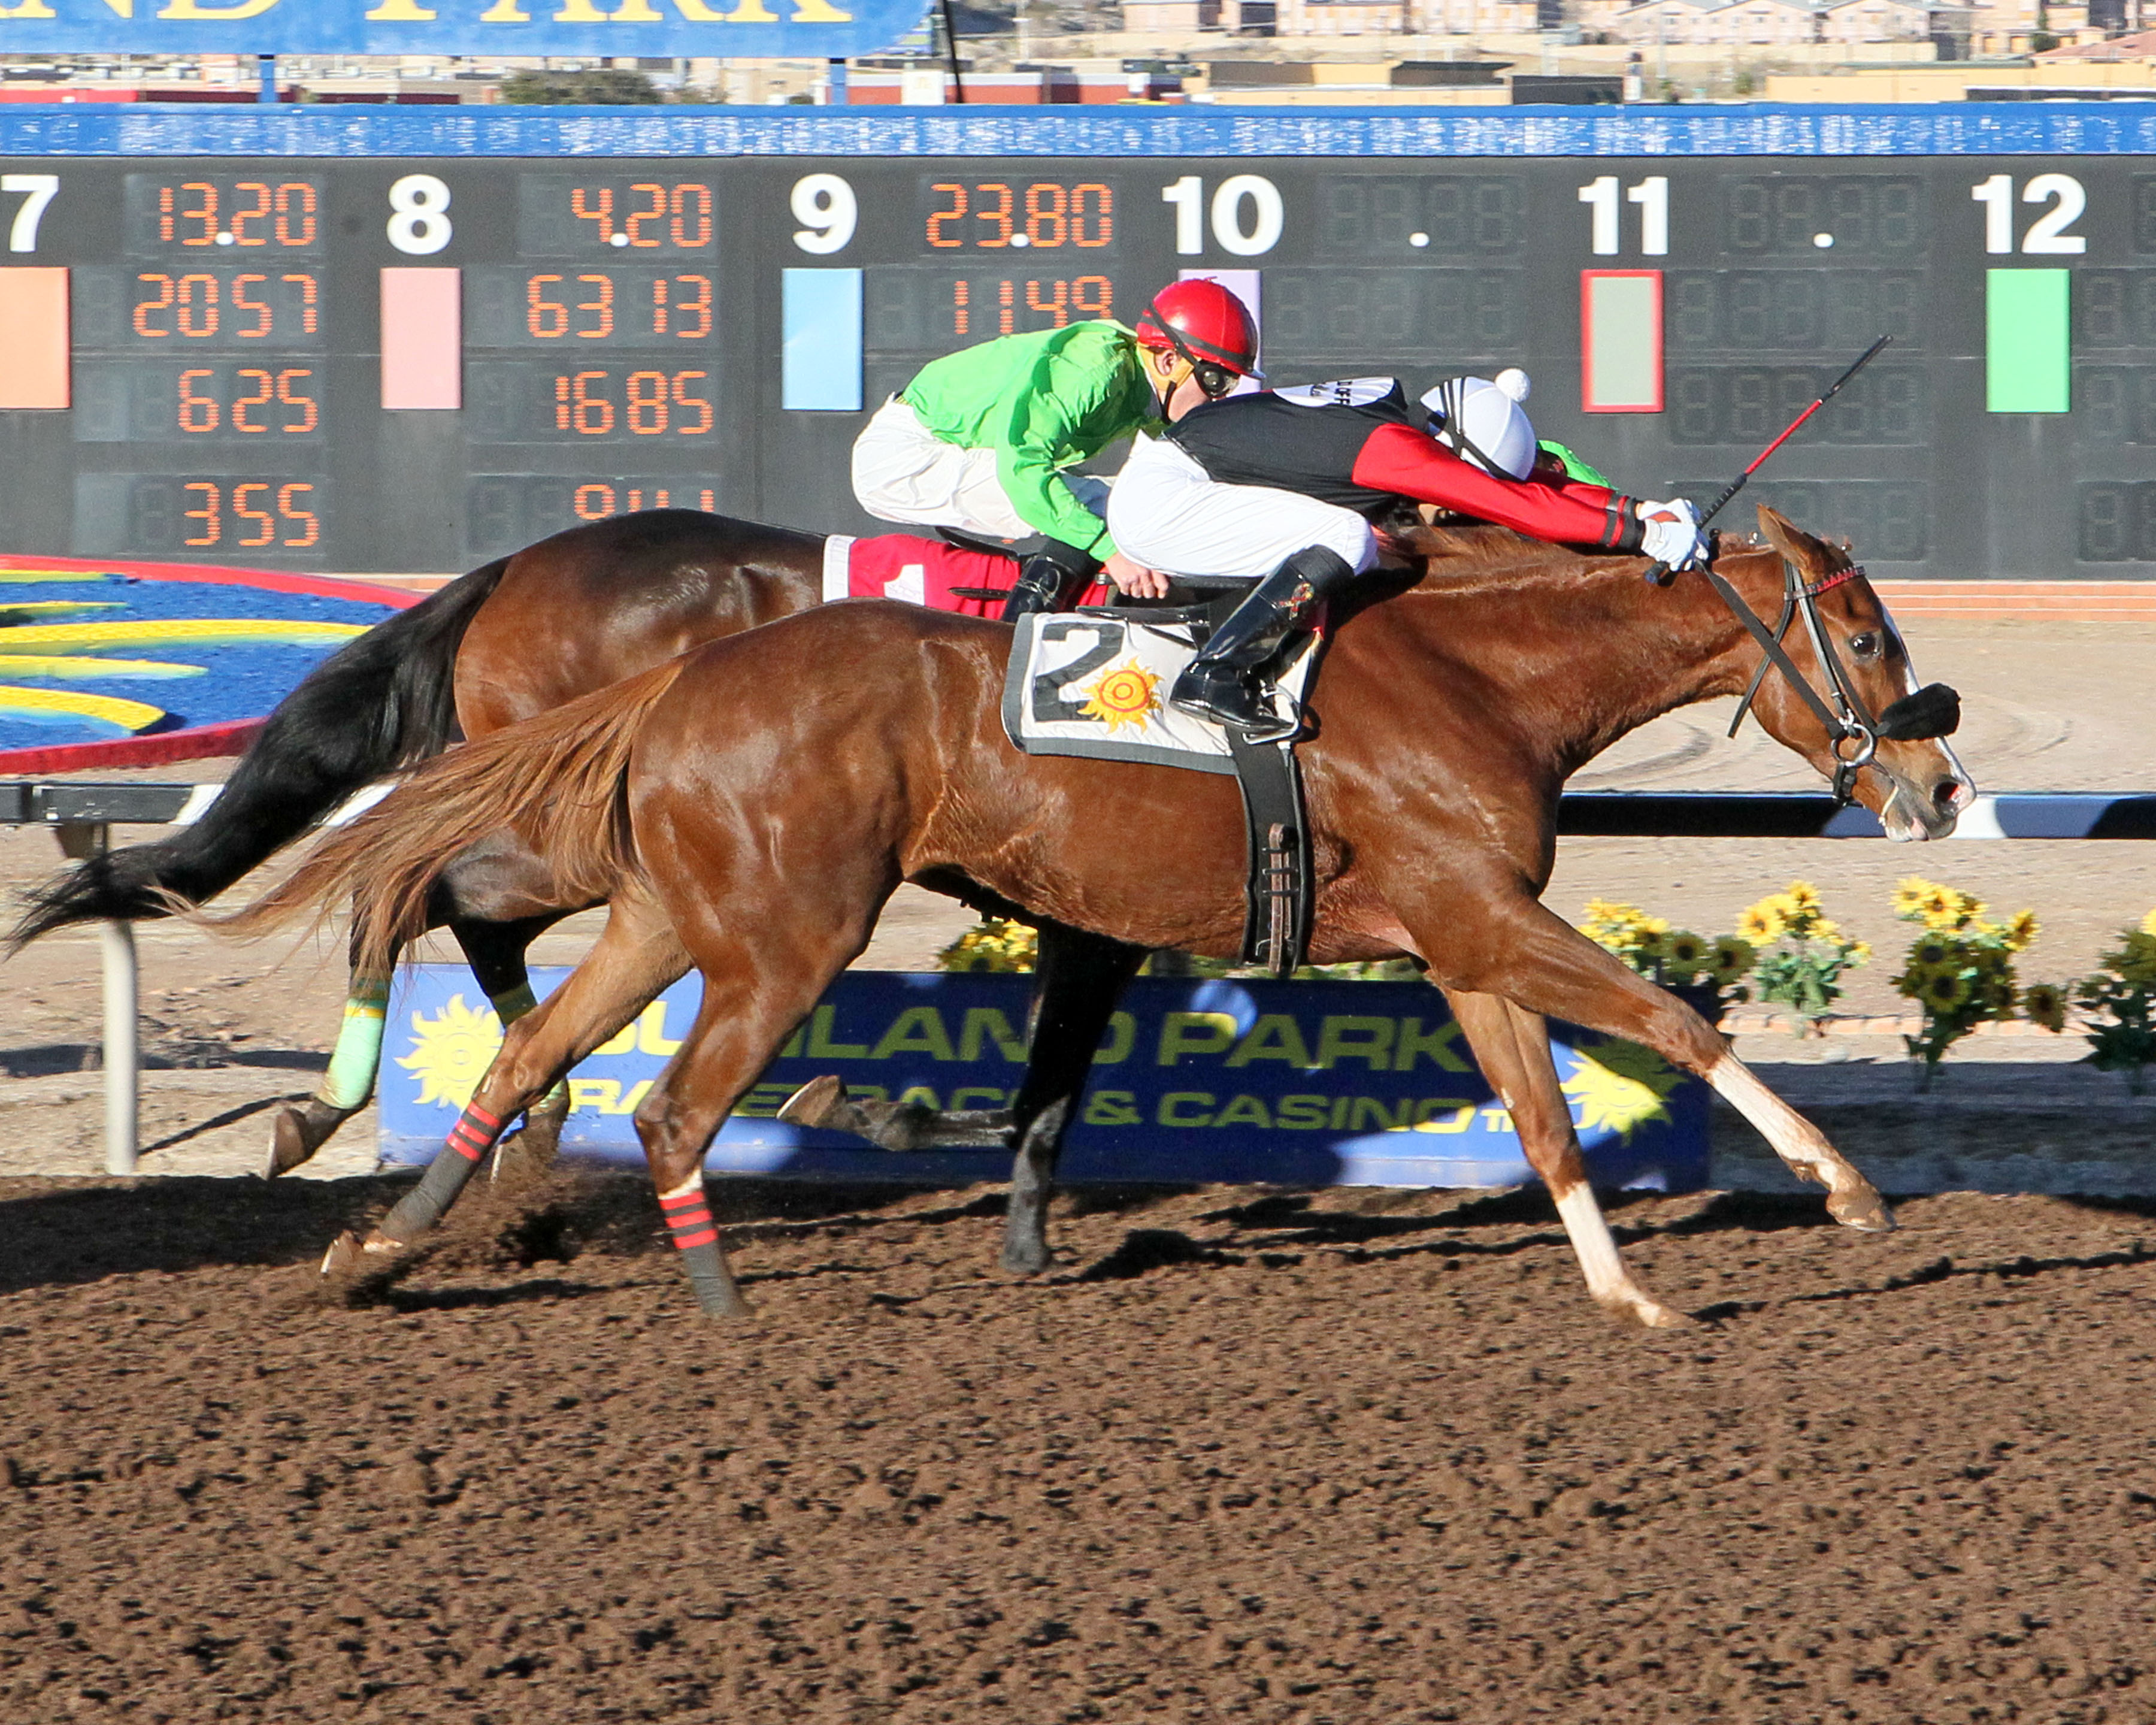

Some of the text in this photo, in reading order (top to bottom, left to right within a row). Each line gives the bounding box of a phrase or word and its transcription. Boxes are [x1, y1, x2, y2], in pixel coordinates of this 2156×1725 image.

[1, 174, 59, 252] 7
[160, 183, 316, 247] 13.20
[387, 174, 452, 255] 8
[571, 183, 712, 248] 4.20
[791, 174, 858, 255] 9
[926, 183, 1113, 249] 23.80
[1162, 175, 1284, 256] 10
[1579, 176, 1669, 255] 11
[1972, 174, 2087, 255] 12
[1034, 621, 1125, 722] 2
[1157, 1011, 1476, 1073] PARK
[1083, 1090, 1143, 1125] &
[1158, 1092, 1477, 1134] CASINO
